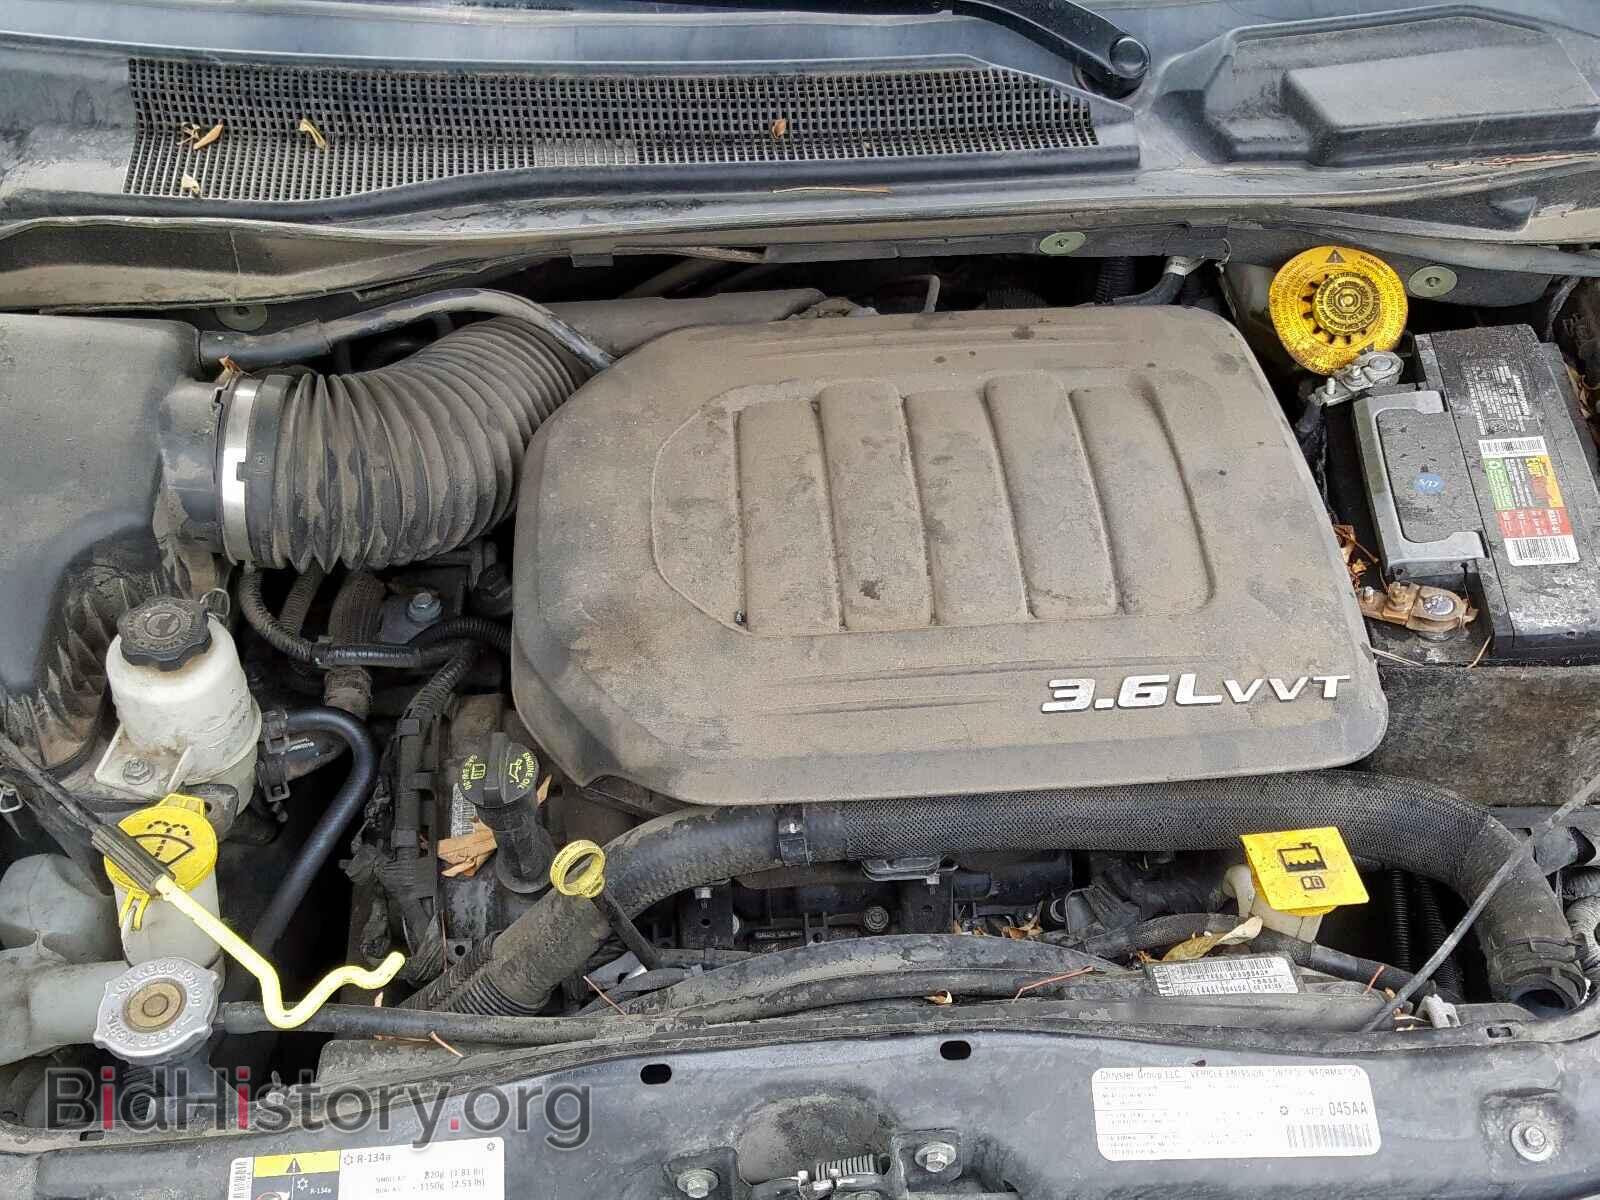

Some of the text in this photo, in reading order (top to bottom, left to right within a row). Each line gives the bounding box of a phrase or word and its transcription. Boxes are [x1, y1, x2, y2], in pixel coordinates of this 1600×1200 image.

[516, 751, 536, 790] ENGINE OIL
[1329, 1101, 1368, 1116] 045AA
